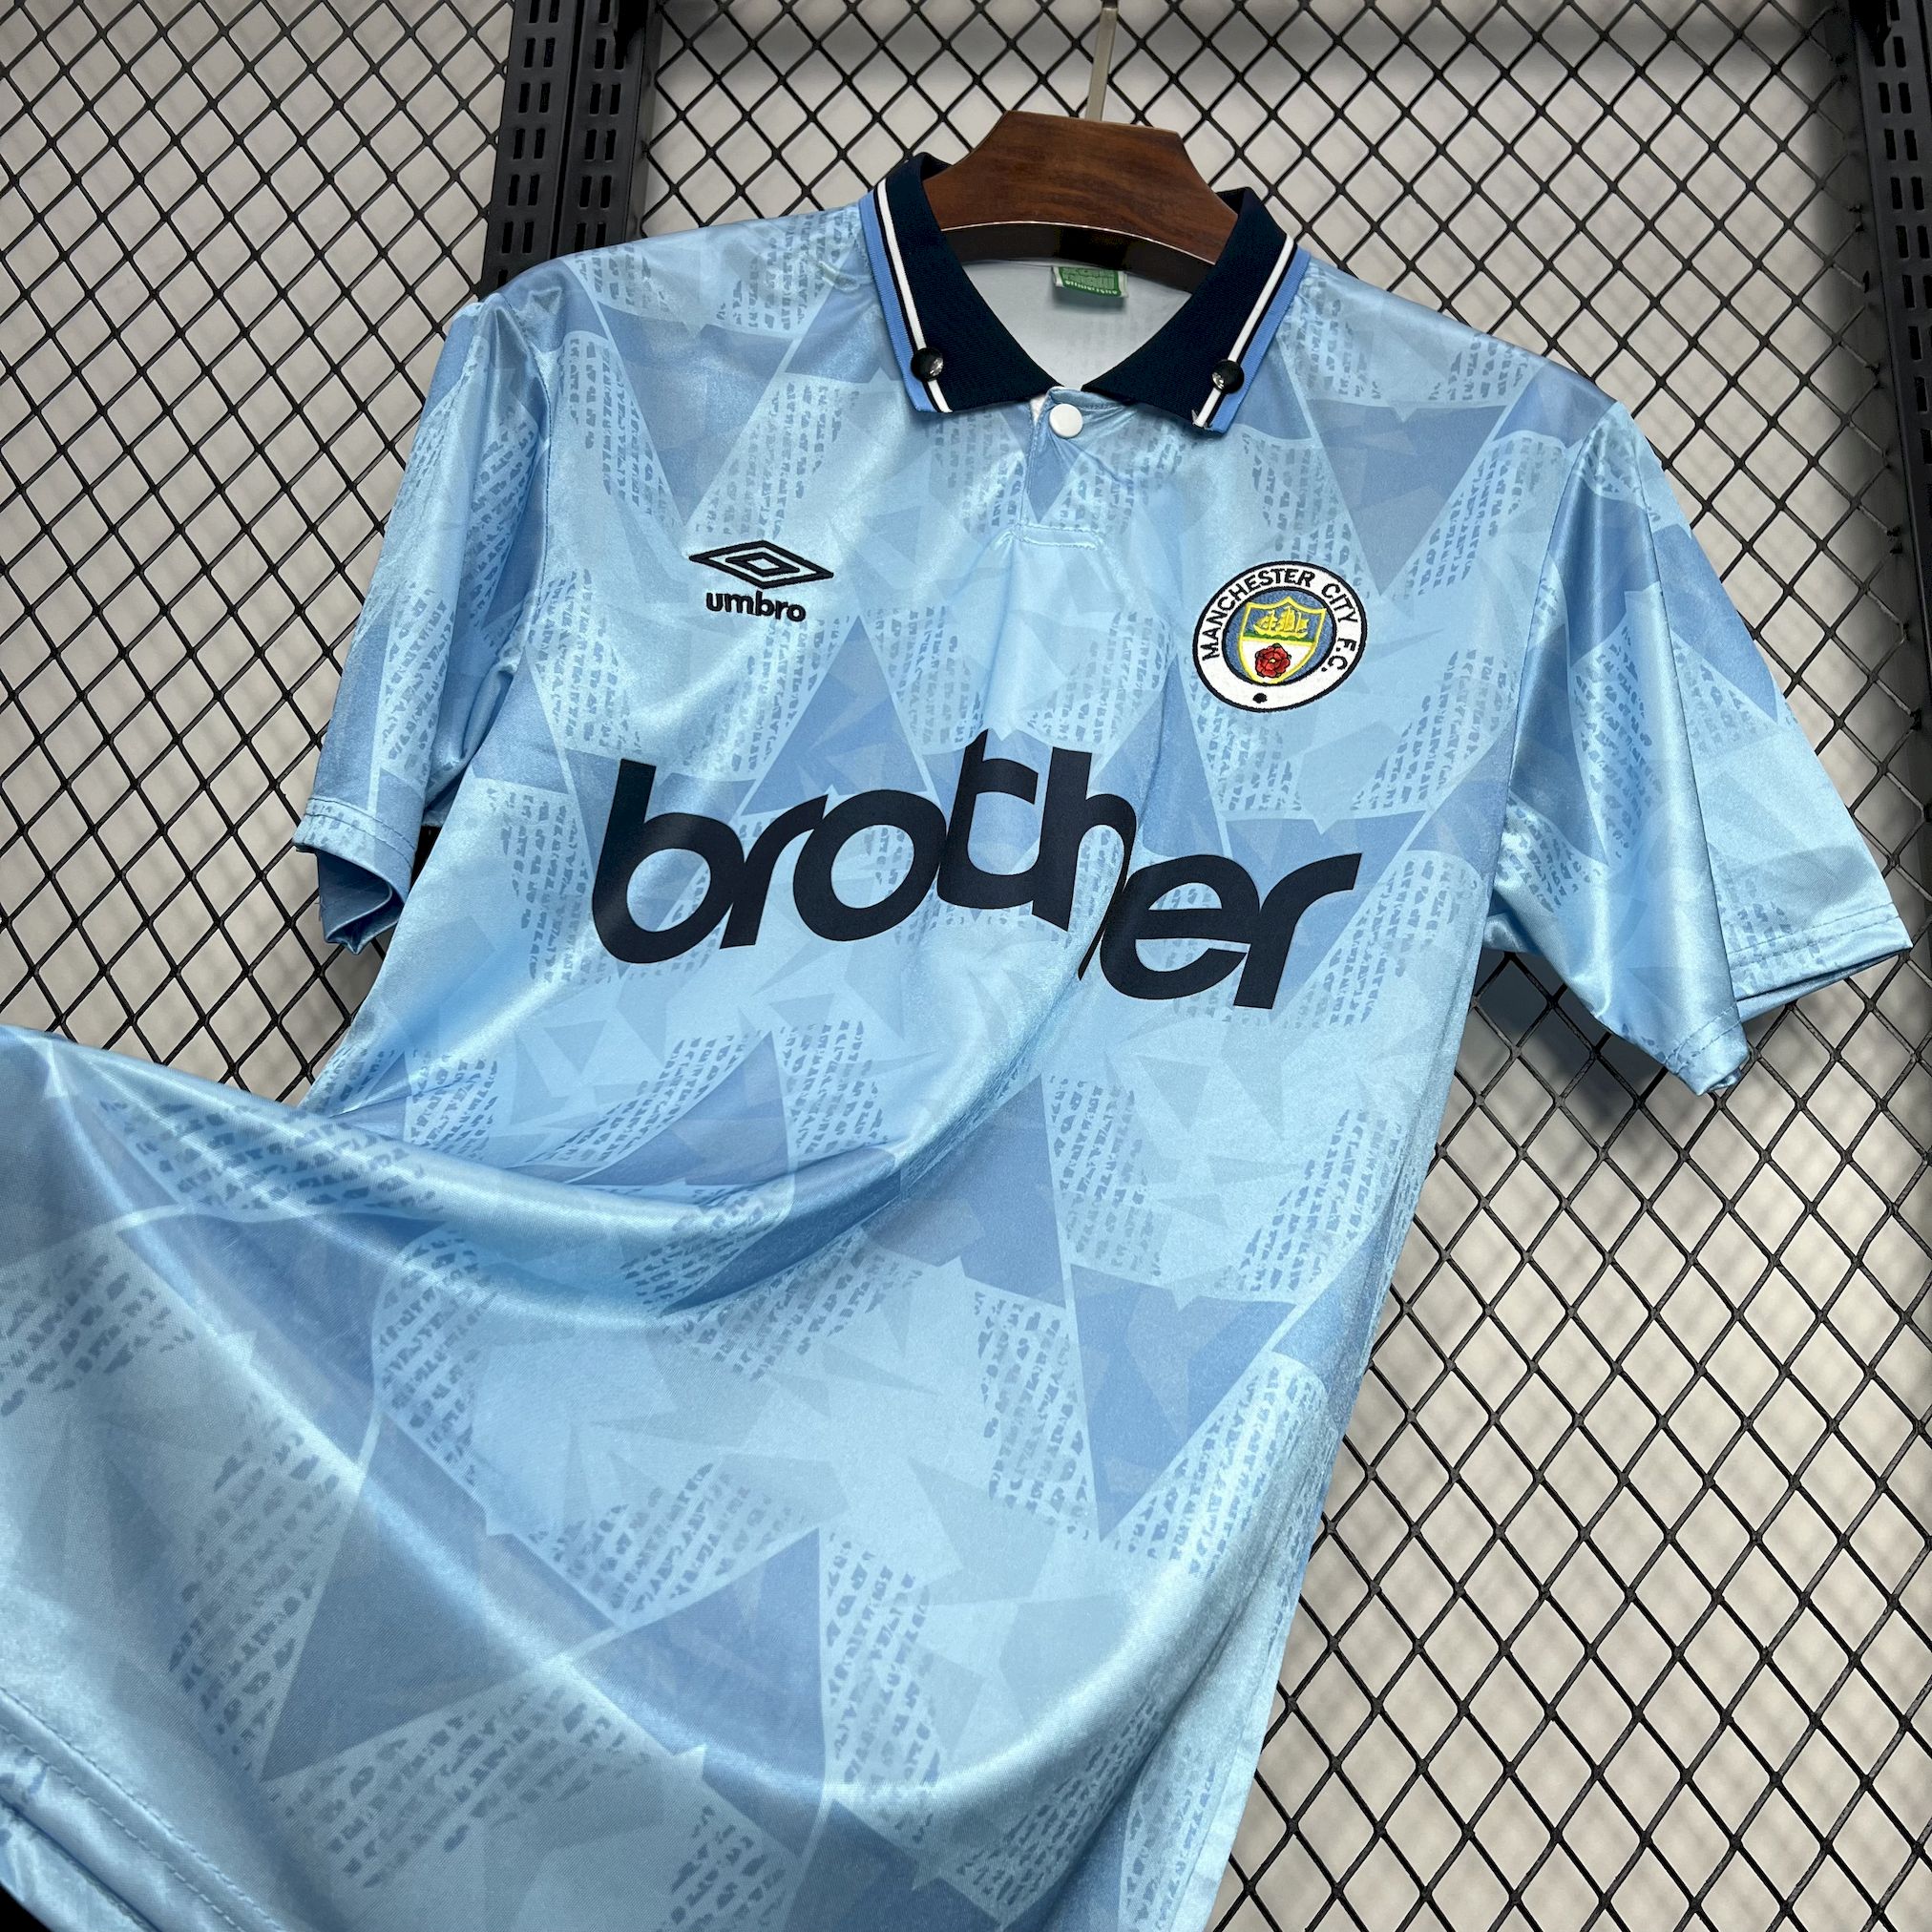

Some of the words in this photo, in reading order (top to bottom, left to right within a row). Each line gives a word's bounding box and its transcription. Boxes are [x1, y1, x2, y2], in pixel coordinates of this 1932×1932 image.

[705, 590, 807, 622] umbro
[1200, 568, 1315, 662] MANCHESTER
[1321, 583, 1358, 623] CITY
[1321, 637, 1357, 673] F.C.
[592, 729, 1362, 1009] brother
